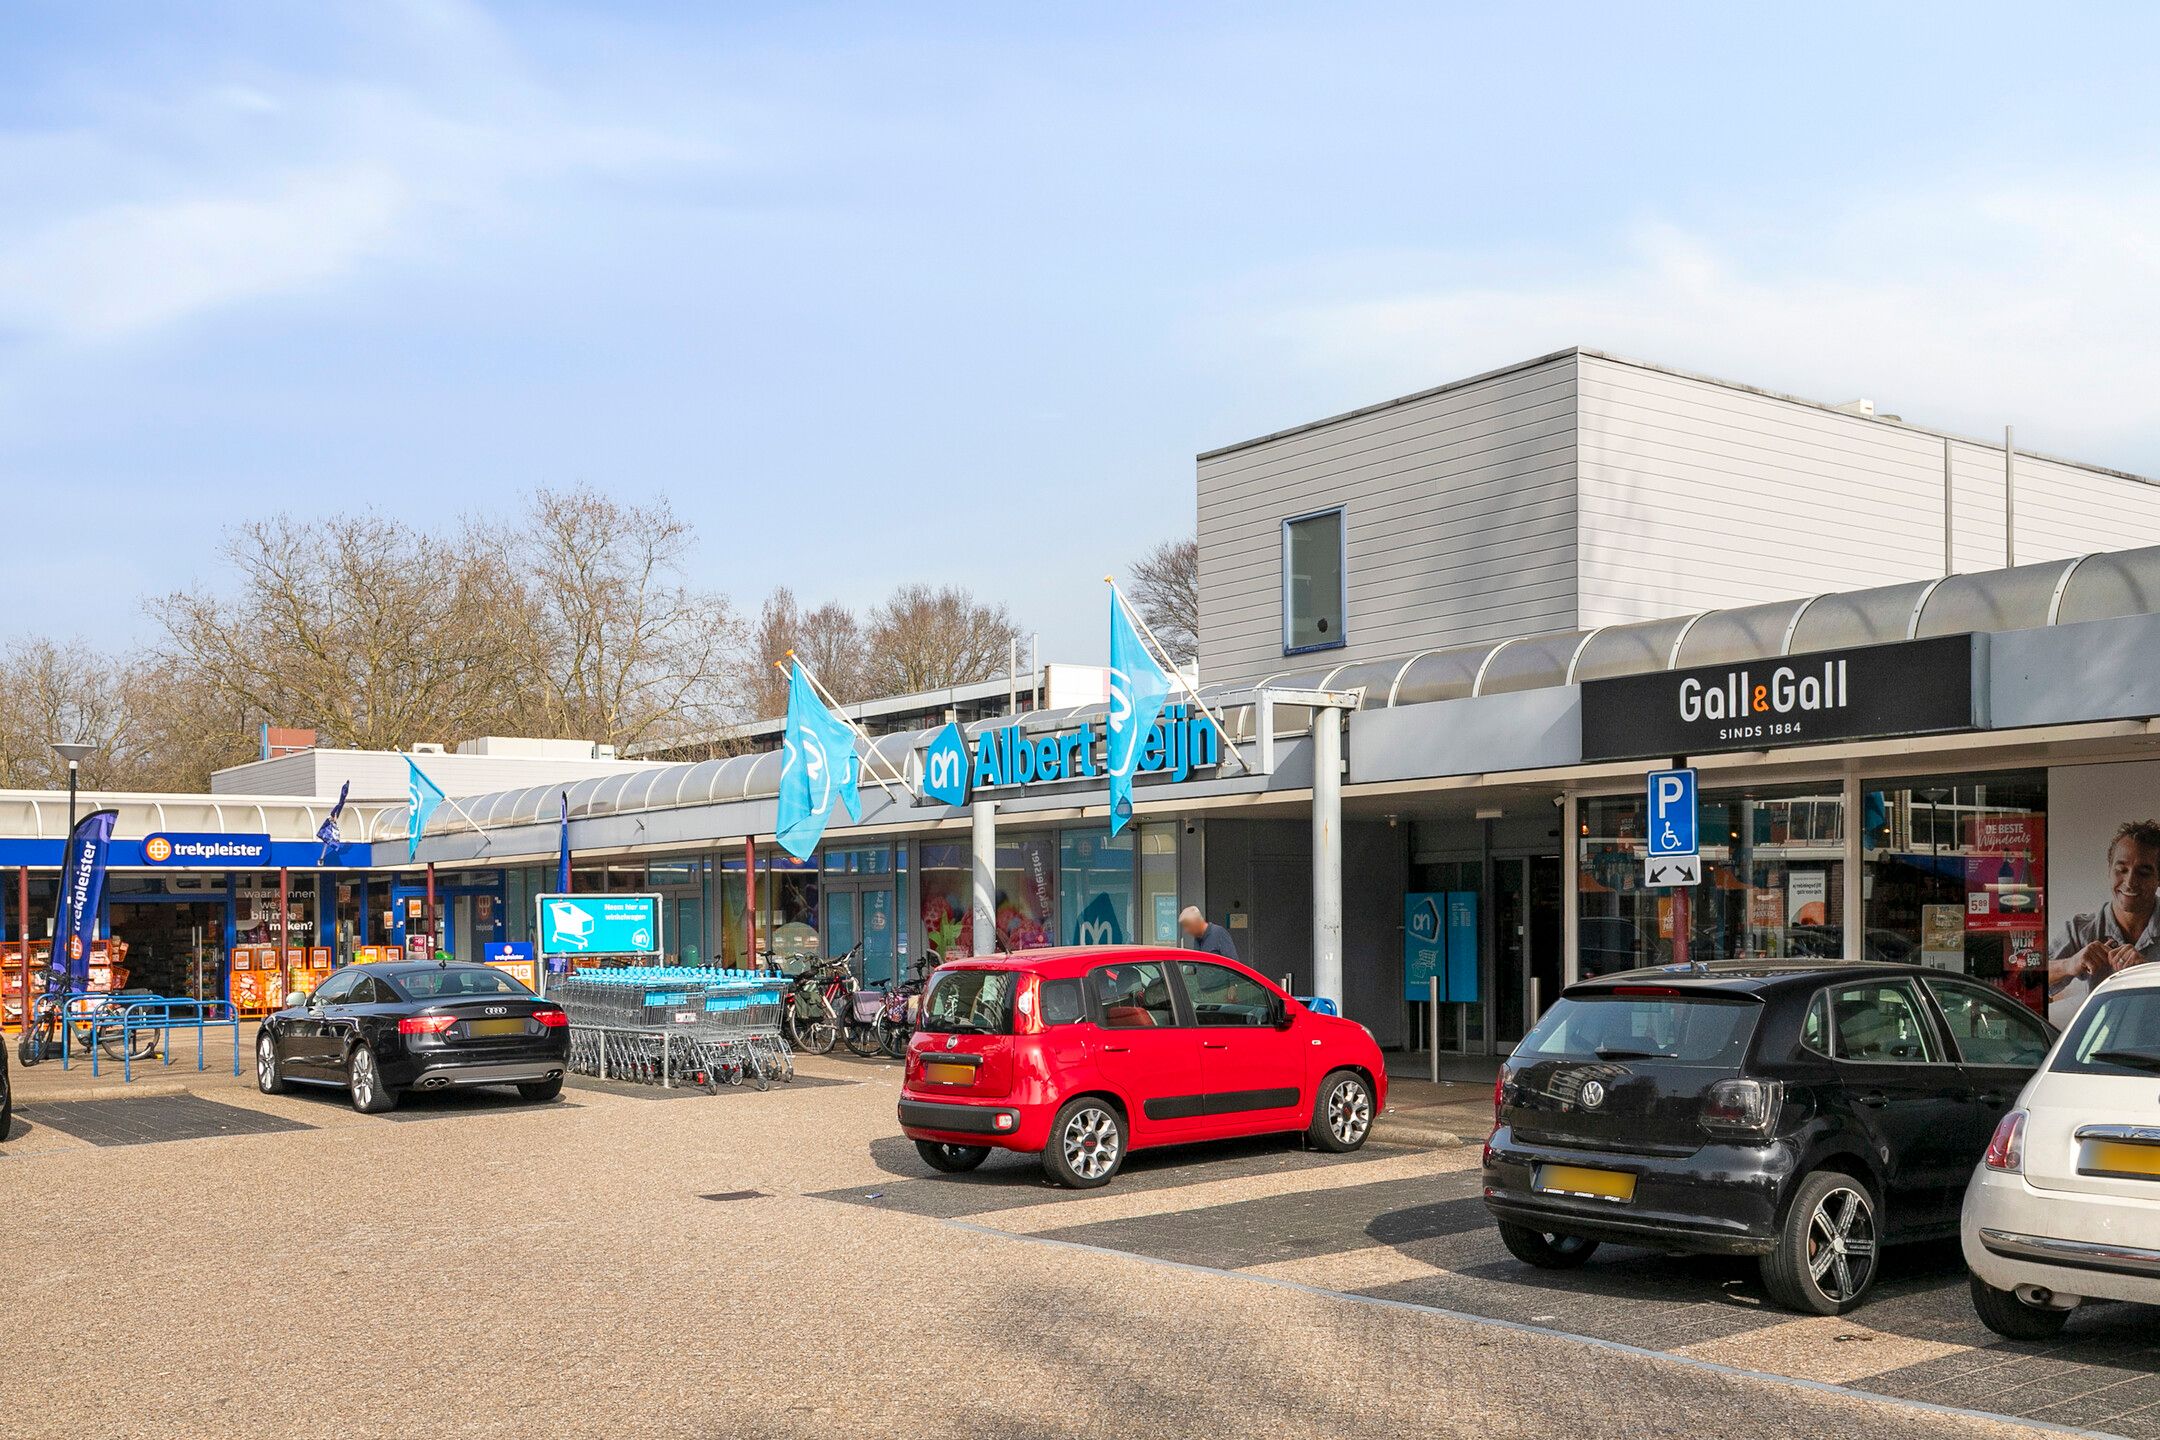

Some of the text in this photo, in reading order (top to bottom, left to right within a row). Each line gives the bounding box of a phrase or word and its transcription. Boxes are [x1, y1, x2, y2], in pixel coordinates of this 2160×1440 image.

[1719, 722, 1802, 740] SINDS 1884
[972, 704, 1220, 787] Albert eijn
[1658, 776, 1684, 820] P
[1999, 823, 2024, 834] BESTE
[174, 841, 263, 858] trekpleister
[244, 888, 316, 899] waar knnen
[260, 901, 277, 910] we
[250, 910, 297, 922] blij me
[269, 921, 314, 931] mken?
